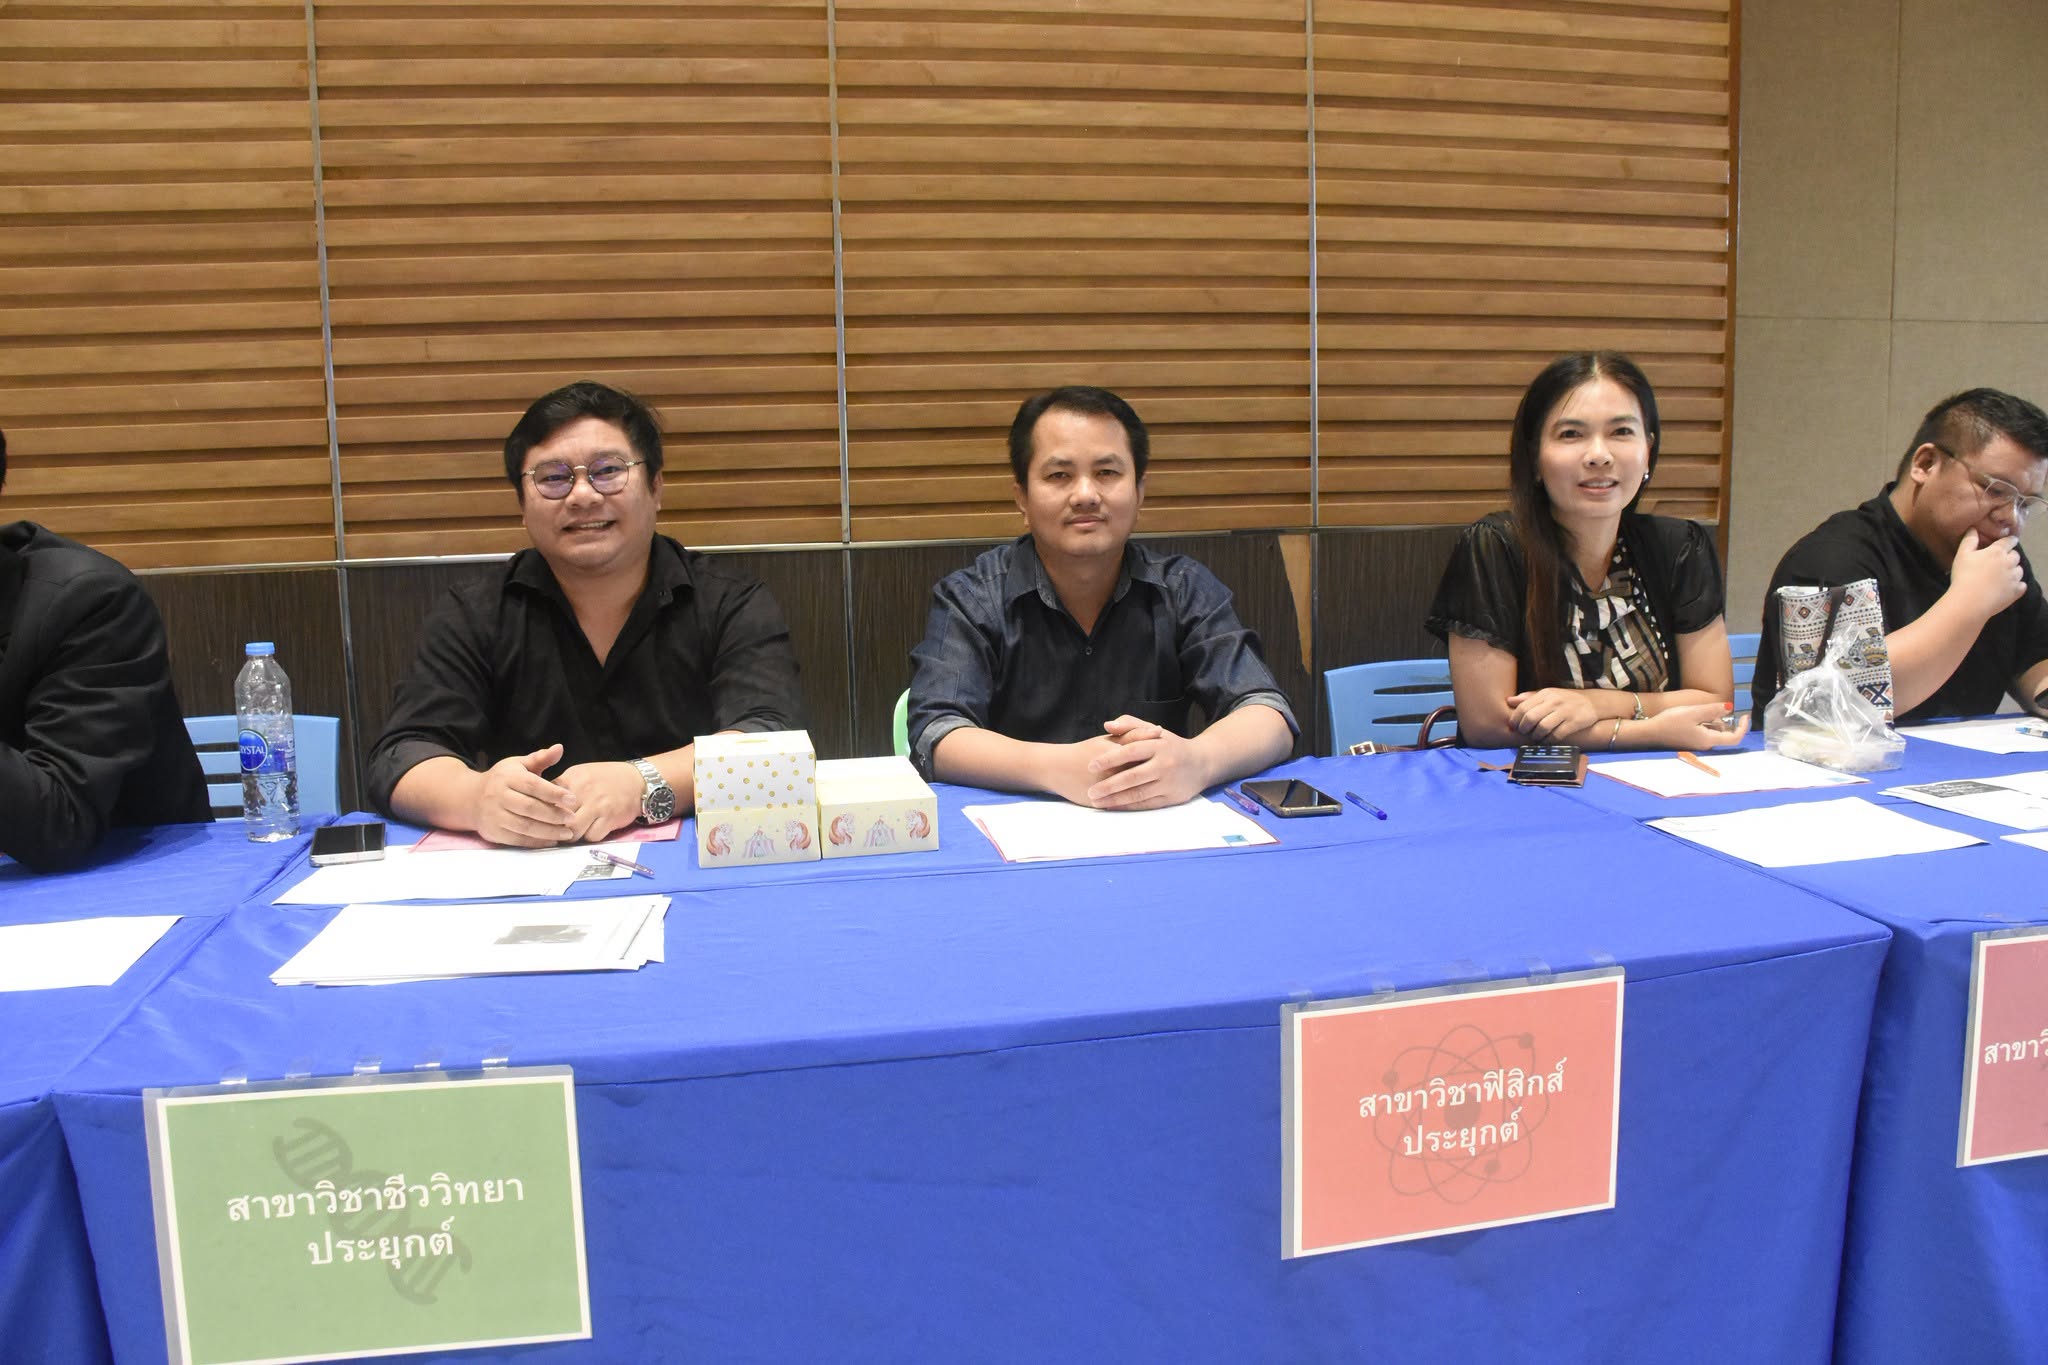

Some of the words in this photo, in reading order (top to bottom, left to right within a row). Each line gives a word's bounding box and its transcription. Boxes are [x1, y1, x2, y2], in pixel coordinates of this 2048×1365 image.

[240, 745, 266, 755] RYSTAL
[1359, 1056, 1568, 1118] สาขาวิชาฟิสิกส์
[1403, 1106, 1523, 1157] ประยุกต์
[227, 1171, 524, 1222] สาขาวิชาชีววิทยา
[307, 1215, 456, 1270] ประยุกต์
